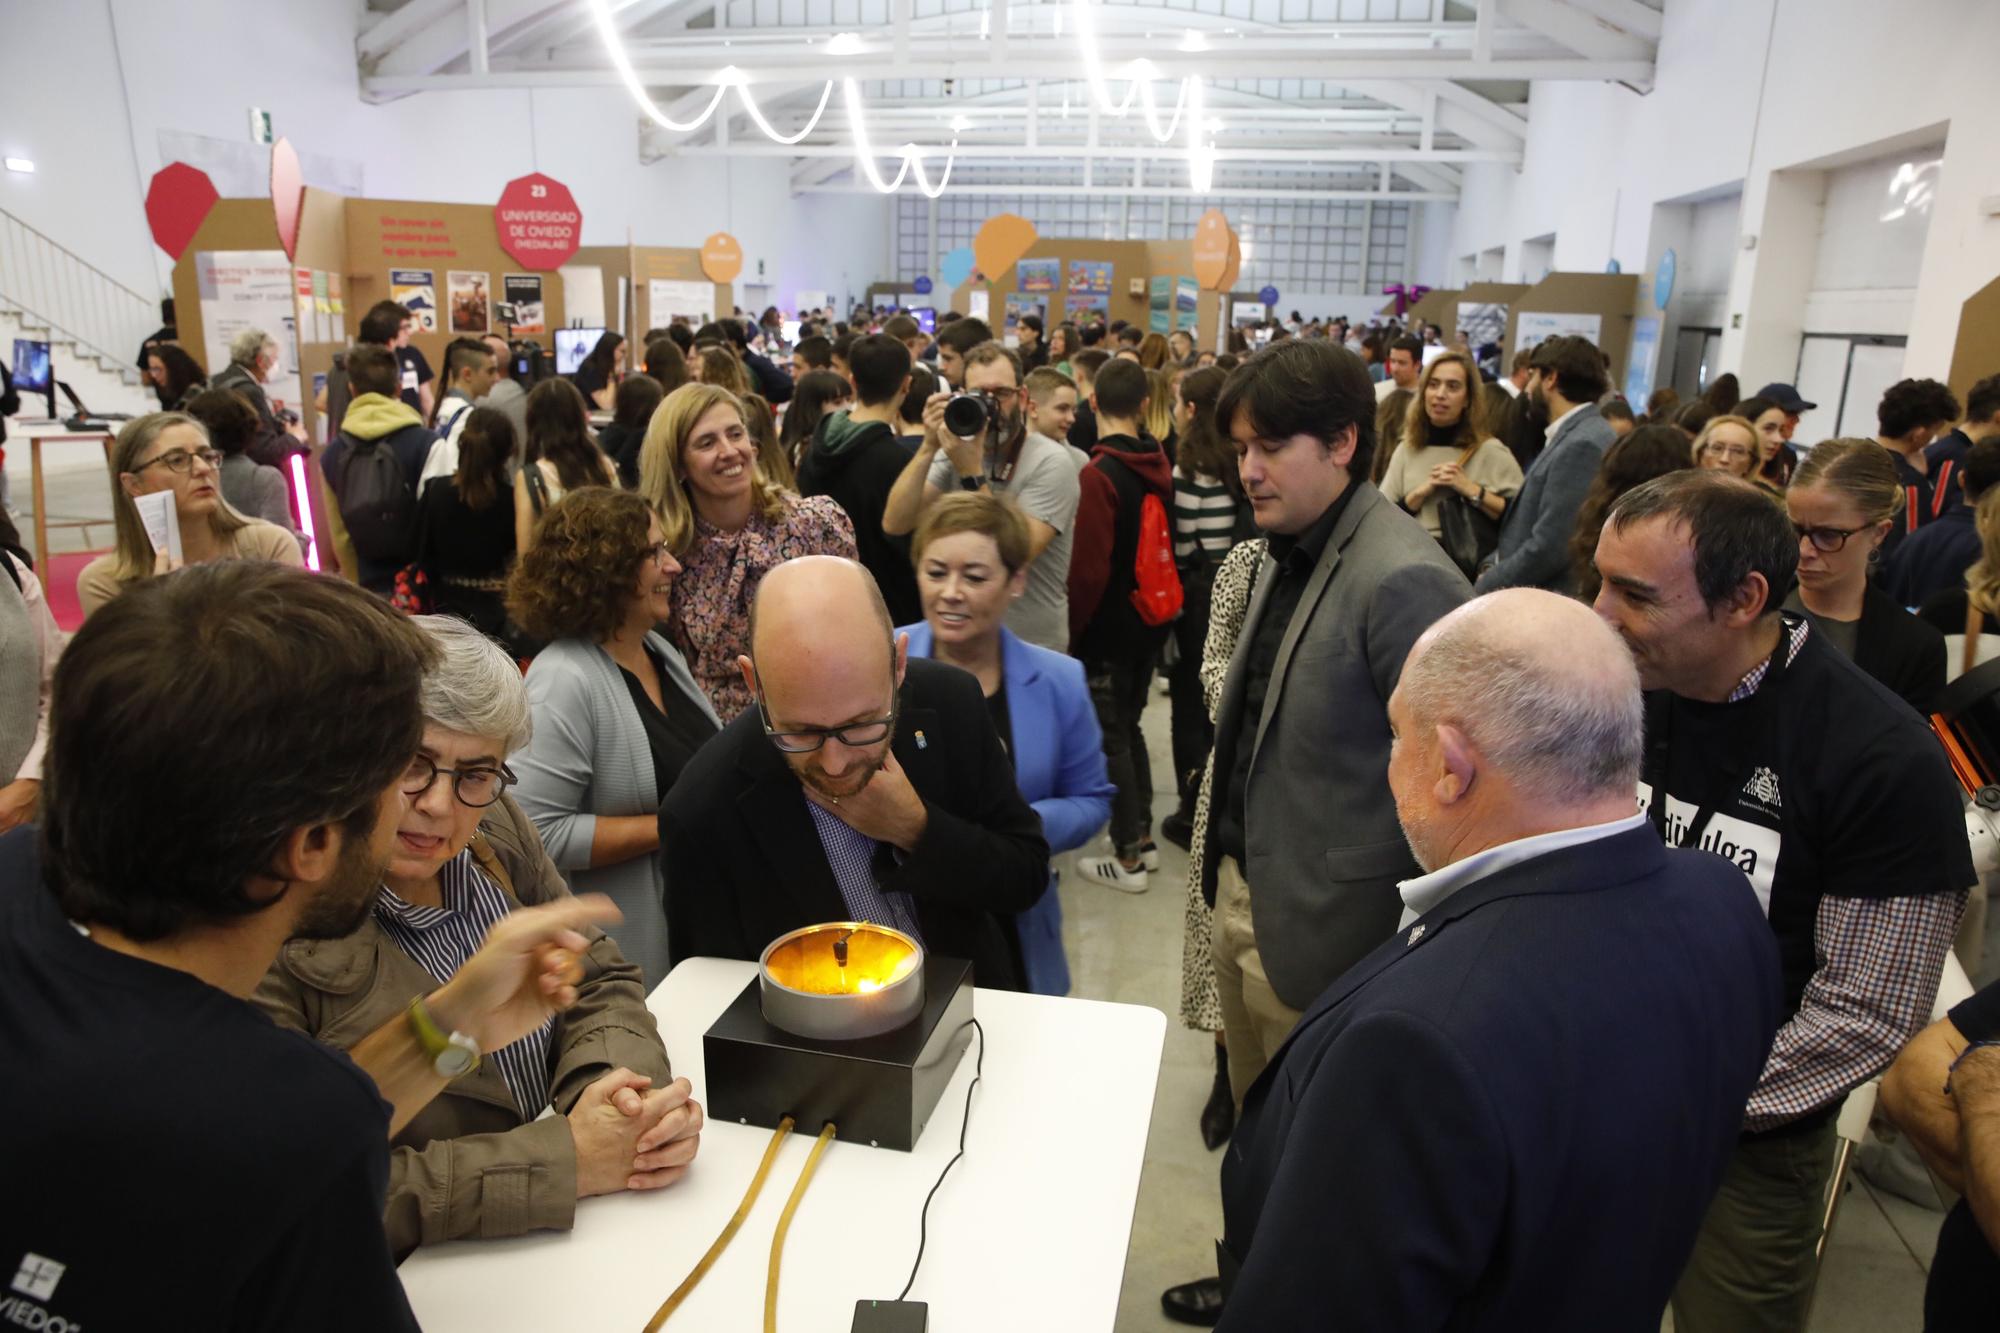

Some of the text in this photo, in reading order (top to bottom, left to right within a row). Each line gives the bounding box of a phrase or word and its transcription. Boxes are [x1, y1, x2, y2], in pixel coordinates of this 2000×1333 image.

[531, 184, 547, 198] 23
[501, 210, 577, 223] UNIVERSIDAD
[509, 225, 572, 238] DE OVIEDO
[514, 239, 569, 250] (MEDIALAB)
